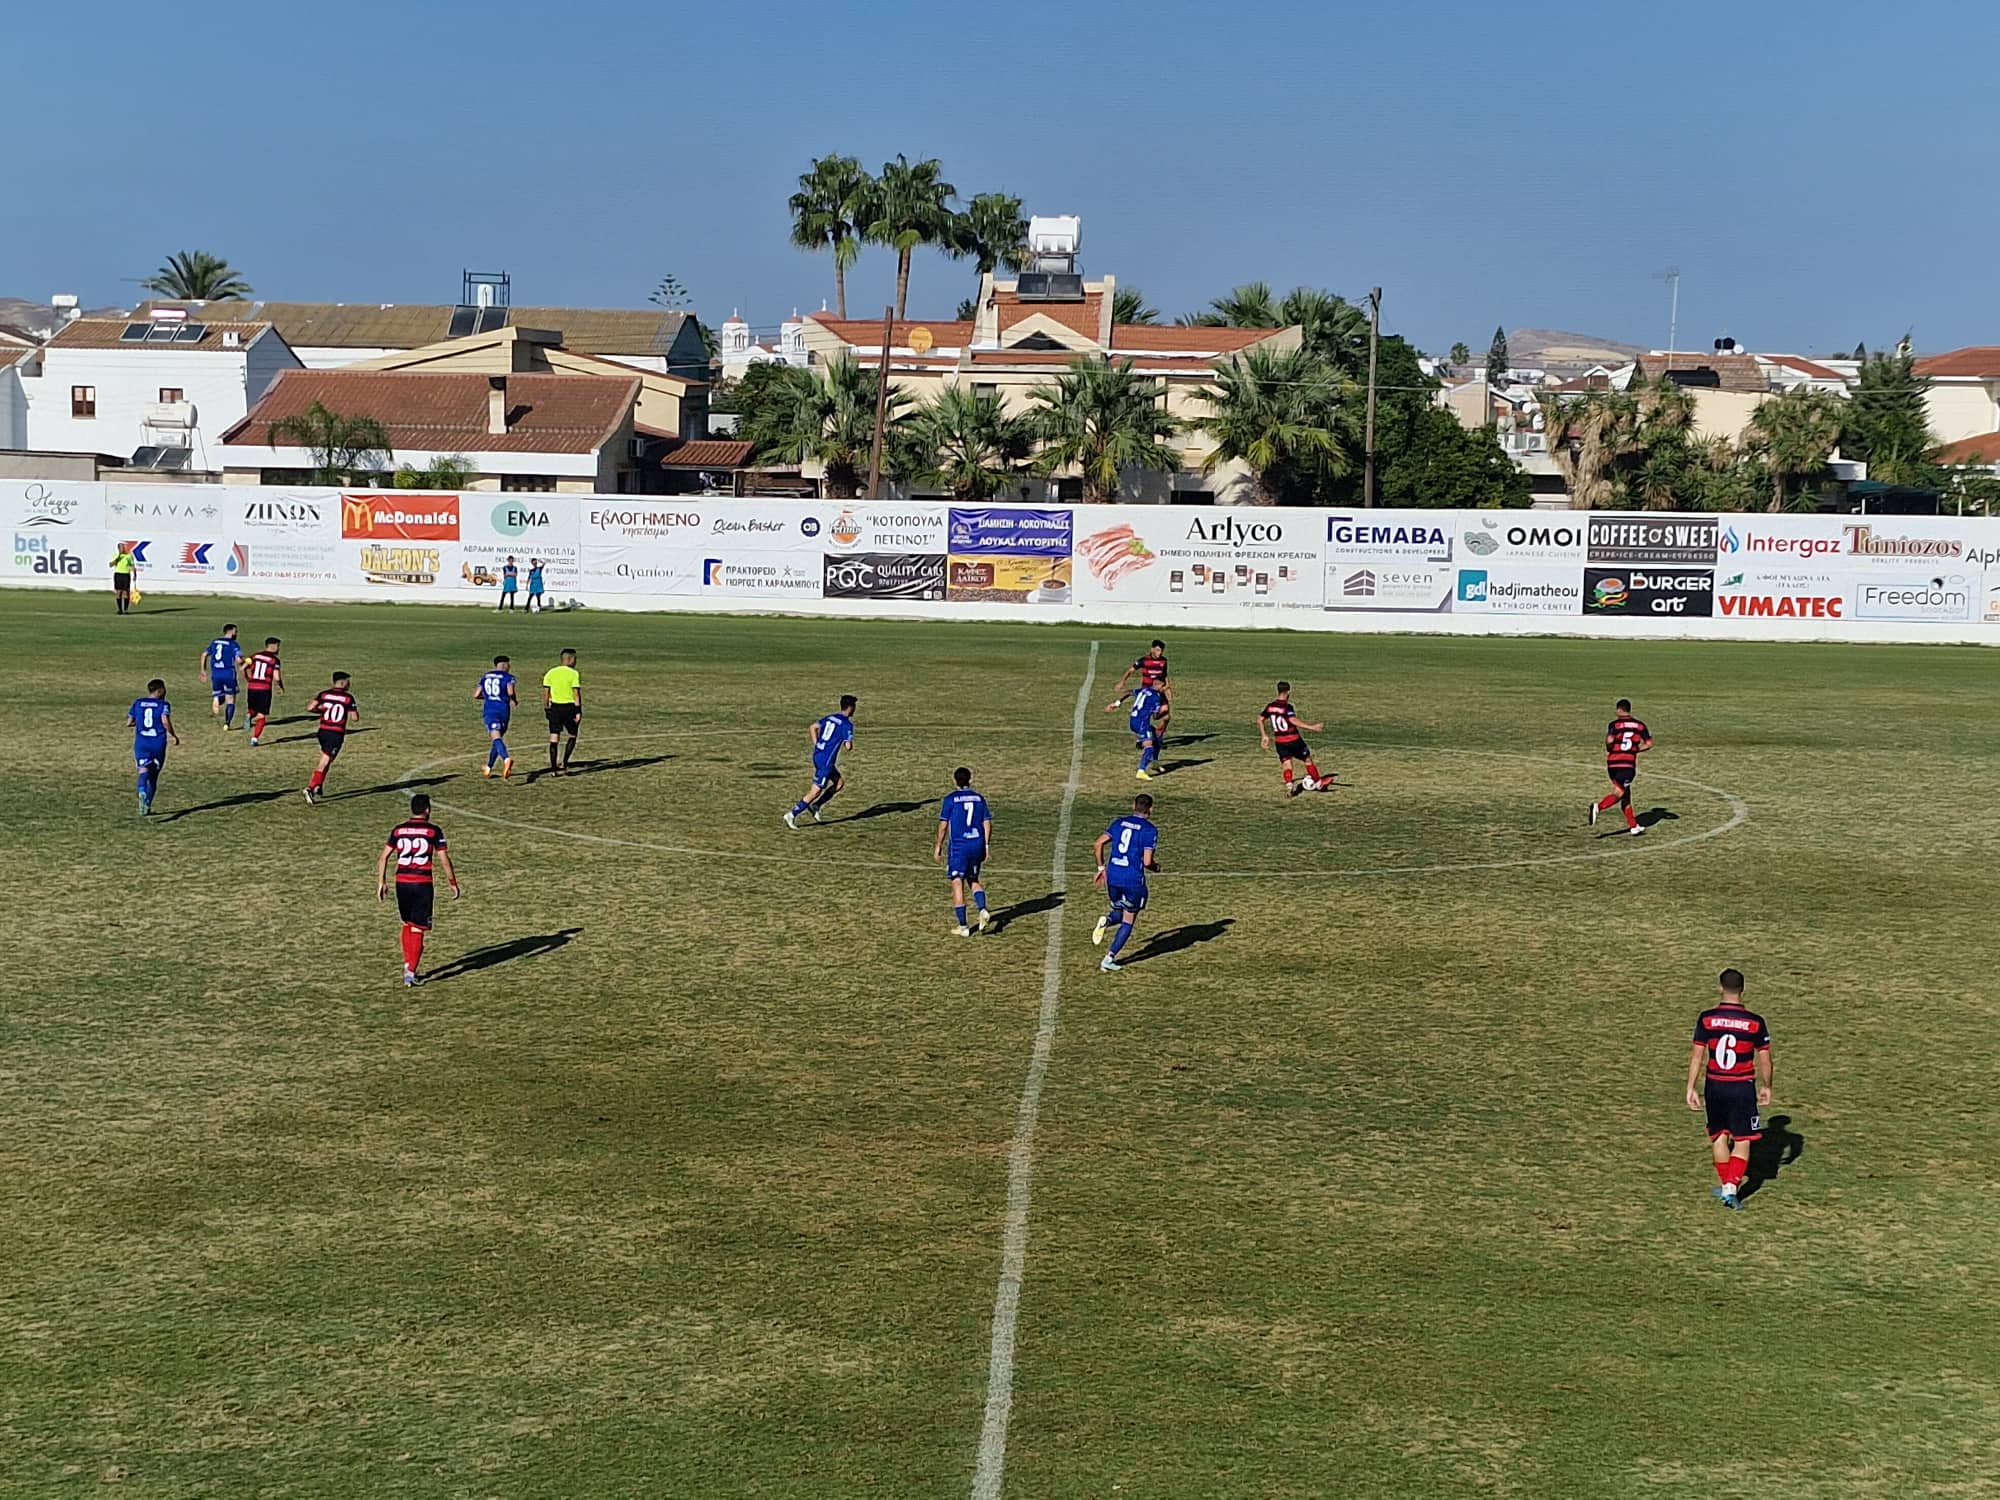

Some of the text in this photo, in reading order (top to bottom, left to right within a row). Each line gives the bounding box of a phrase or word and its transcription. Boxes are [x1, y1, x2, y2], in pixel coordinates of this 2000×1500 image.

[134, 504, 194, 516] NAVA
[374, 511, 457, 524] McDonald's
[508, 511, 549, 526] EMA
[1186, 516, 1282, 547] Arlyco
[1336, 526, 1445, 544] GEMABA
[1507, 527, 1581, 546] OMOI
[1590, 525, 1718, 547] COFFEE SWEET
[15, 533, 48, 552] bet
[1747, 532, 1840, 558] Intergaz
[15, 549, 82, 574] on alfa
[361, 548, 440, 573] DALTON'S
[826, 567, 874, 588] PQC
[877, 565, 944, 577] QUALITY CARS
[1383, 573, 1432, 583] seven
[1490, 582, 1578, 600] hadjimatheou
[1865, 588, 1965, 605] Freedom
[1492, 602, 1539, 610] BATHROOM
[1651, 597, 1687, 612] art
[1719, 596, 1842, 617] VIMATEC
[484, 678, 500, 697] 66
[322, 702, 345, 723] 70
[1270, 714, 1288, 732] 10
[1620, 732, 1633, 751] 5
[964, 802, 974, 826] 7
[1118, 828, 1132, 853] 9
[397, 838, 428, 865] 22
[1715, 1034, 1736, 1070] 6
